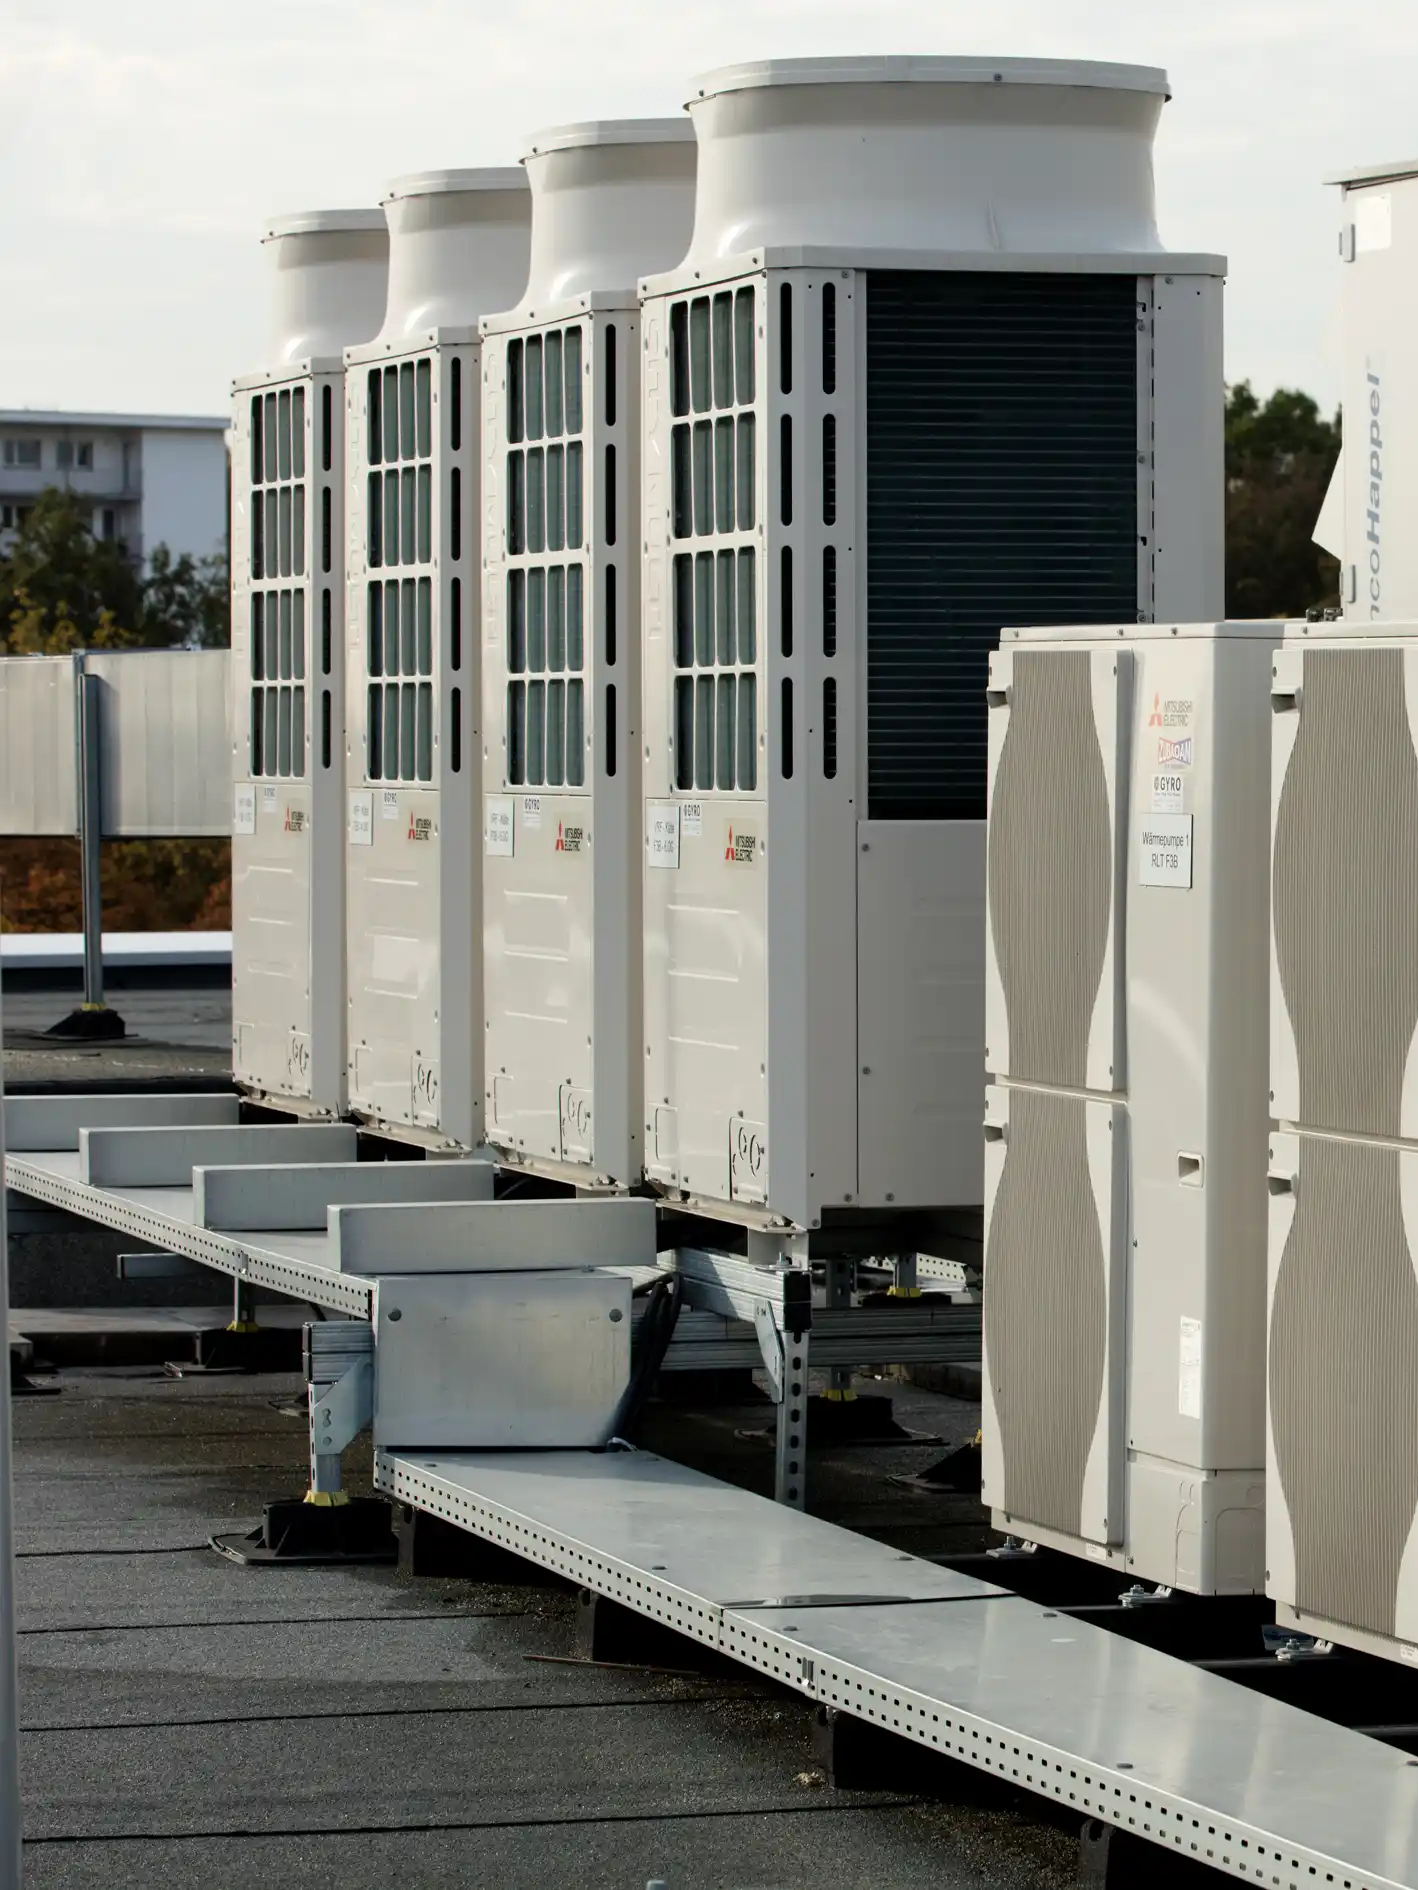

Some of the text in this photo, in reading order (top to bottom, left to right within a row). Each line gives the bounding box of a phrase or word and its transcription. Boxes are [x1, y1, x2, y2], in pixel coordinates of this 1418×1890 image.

[1164, 701, 1192, 713] MITSUBISHI
[1163, 714, 1188, 727] ELECTRIC
[1160, 777, 1181, 791] GYRO
[1142, 832, 1184, 850] Wärmepumpe
[1151, 853, 1179, 869] RLT F3B
